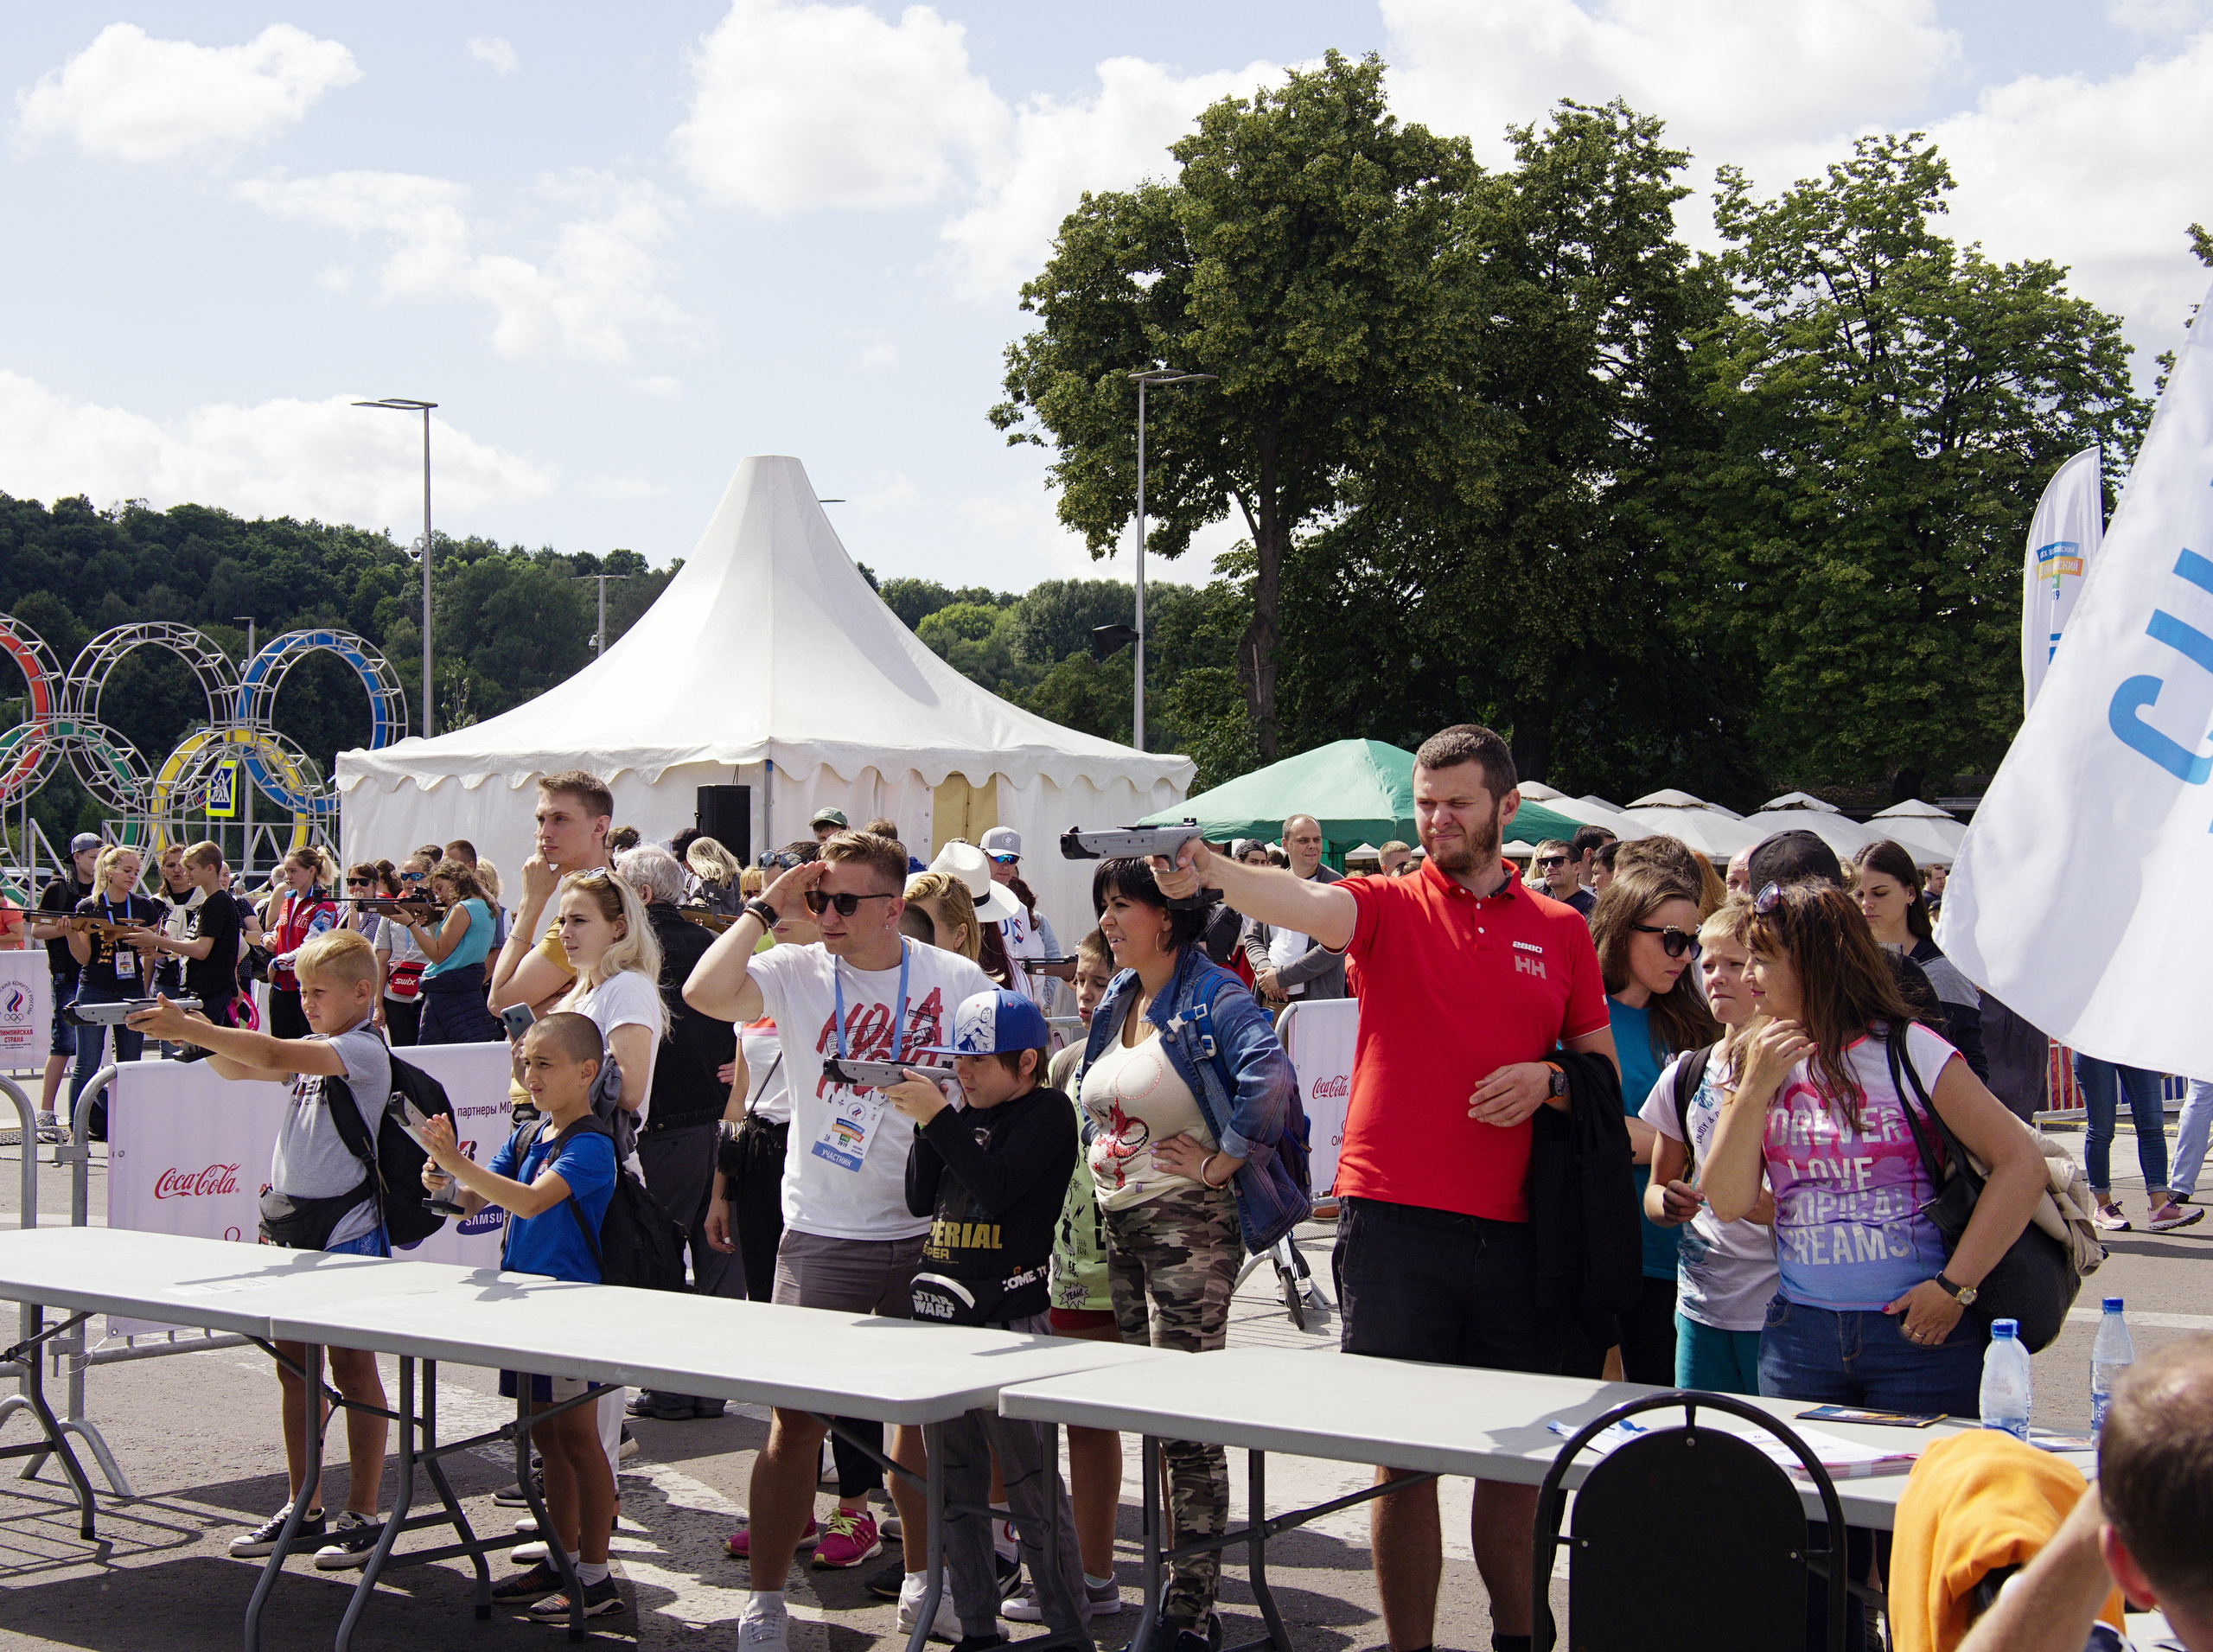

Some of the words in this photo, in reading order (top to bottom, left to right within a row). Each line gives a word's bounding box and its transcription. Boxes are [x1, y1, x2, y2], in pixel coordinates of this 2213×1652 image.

[1515, 955, 1547, 980] HH
[457, 1105, 497, 1119] партнеры
[500, 1100, 513, 1113] МО
[1696, 1122, 1708, 1144] ENJOY
[1766, 1107, 1903, 1146] OREVER
[821, 1148, 852, 1167] УЧАСТНИК
[155, 1163, 240, 1199] Coca-Cola
[465, 1212, 502, 1227] SAMSU
[930, 1221, 1003, 1249] PERIAL
[912, 1290, 953, 1306] STAR
[1065, 1289, 1084, 1301] YEAH!
[912, 1299, 955, 1319] WARS
